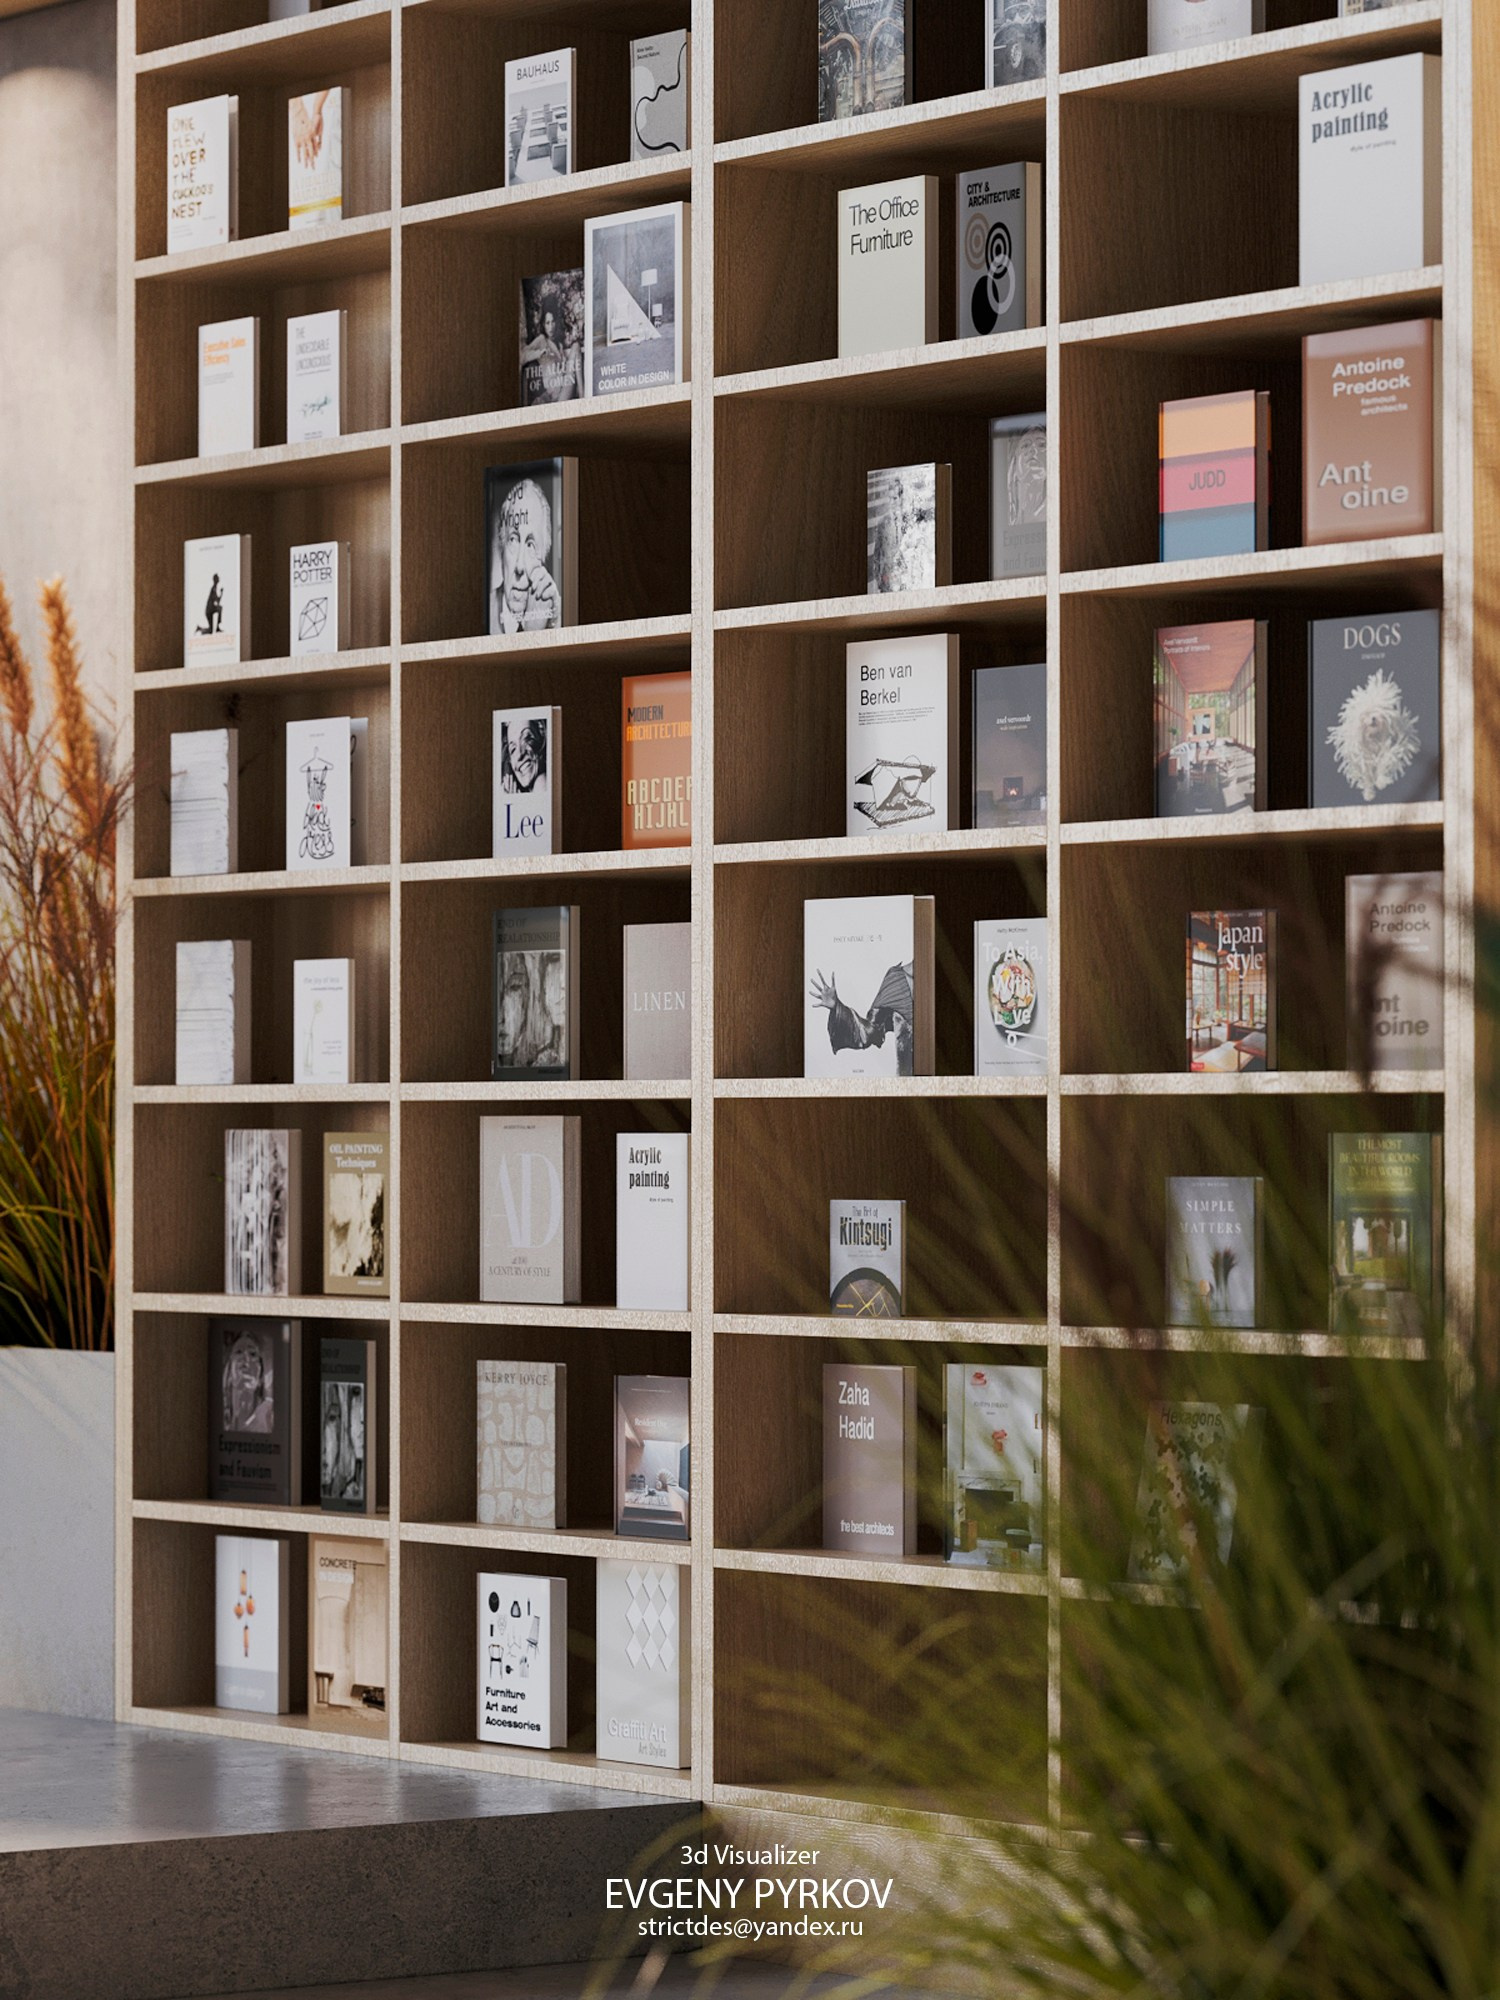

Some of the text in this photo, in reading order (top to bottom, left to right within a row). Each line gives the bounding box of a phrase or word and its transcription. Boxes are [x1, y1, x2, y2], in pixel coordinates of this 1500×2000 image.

[516, 60, 560, 81] BAUHAUS
[1311, 82, 1373, 112] Acrylic
[1311, 107, 1389, 143] painting
[172, 148, 206, 168] OVER
[967, 181, 990, 196] CITY &
[968, 188, 1021, 208] ARCHITECTURE
[171, 201, 202, 219] NEST
[849, 196, 920, 227] The Office
[850, 228, 914, 255] Furniture
[525, 364, 543, 380] THE
[600, 363, 627, 377] WHITE
[1331, 356, 1405, 378] Antoine
[528, 379, 542, 392] OF
[598, 371, 670, 391] COLOR IN DESIGN
[1332, 374, 1412, 398] Predock
[1189, 469, 1226, 491] JUDD
[1319, 461, 1372, 487] Ant
[1341, 484, 1409, 509] oine
[293, 549, 333, 569] HARRY
[293, 567, 333, 583] POTTER
[1343, 622, 1402, 650] DOGS
[860, 664, 912, 682] Ben van
[860, 687, 901, 706] Berkel
[627, 705, 664, 723] MODERN
[626, 721, 691, 742] ARCHITECTUR
[503, 803, 544, 839] Lee
[1370, 902, 1426, 915] Antoine
[1369, 918, 1431, 933] Predock
[1217, 921, 1264, 952] Japan
[982, 942, 1000, 961] To
[1225, 945, 1263, 979] style
[633, 991, 686, 1012] LINEN
[1374, 994, 1400, 1013] nt
[1375, 1016, 1429, 1037] oine
[329, 1143, 384, 1155] OIL PAINTING
[629, 1147, 662, 1166] Acrylic
[335, 1156, 377, 1171] Techniques
[629, 1171, 670, 1190] painting
[484, 1151, 562, 1249] AD
[1186, 1200, 1235, 1212] SIMPLE
[839, 1216, 892, 1251] Kintsugi
[484, 1372, 548, 1386] KERRY JOYCE
[838, 1381, 869, 1406] Zaha
[839, 1415, 875, 1440] Hadid
[1160, 1407, 1223, 1430] Hexagons
[219, 1434, 280, 1455] Expressionism
[219, 1458, 272, 1478] and Fauvism
[485, 1686, 526, 1701] Furniture
[485, 1701, 518, 1713] Art and
[485, 1716, 541, 1732] Accessories
[607, 1717, 667, 1743] Graffiti Art
